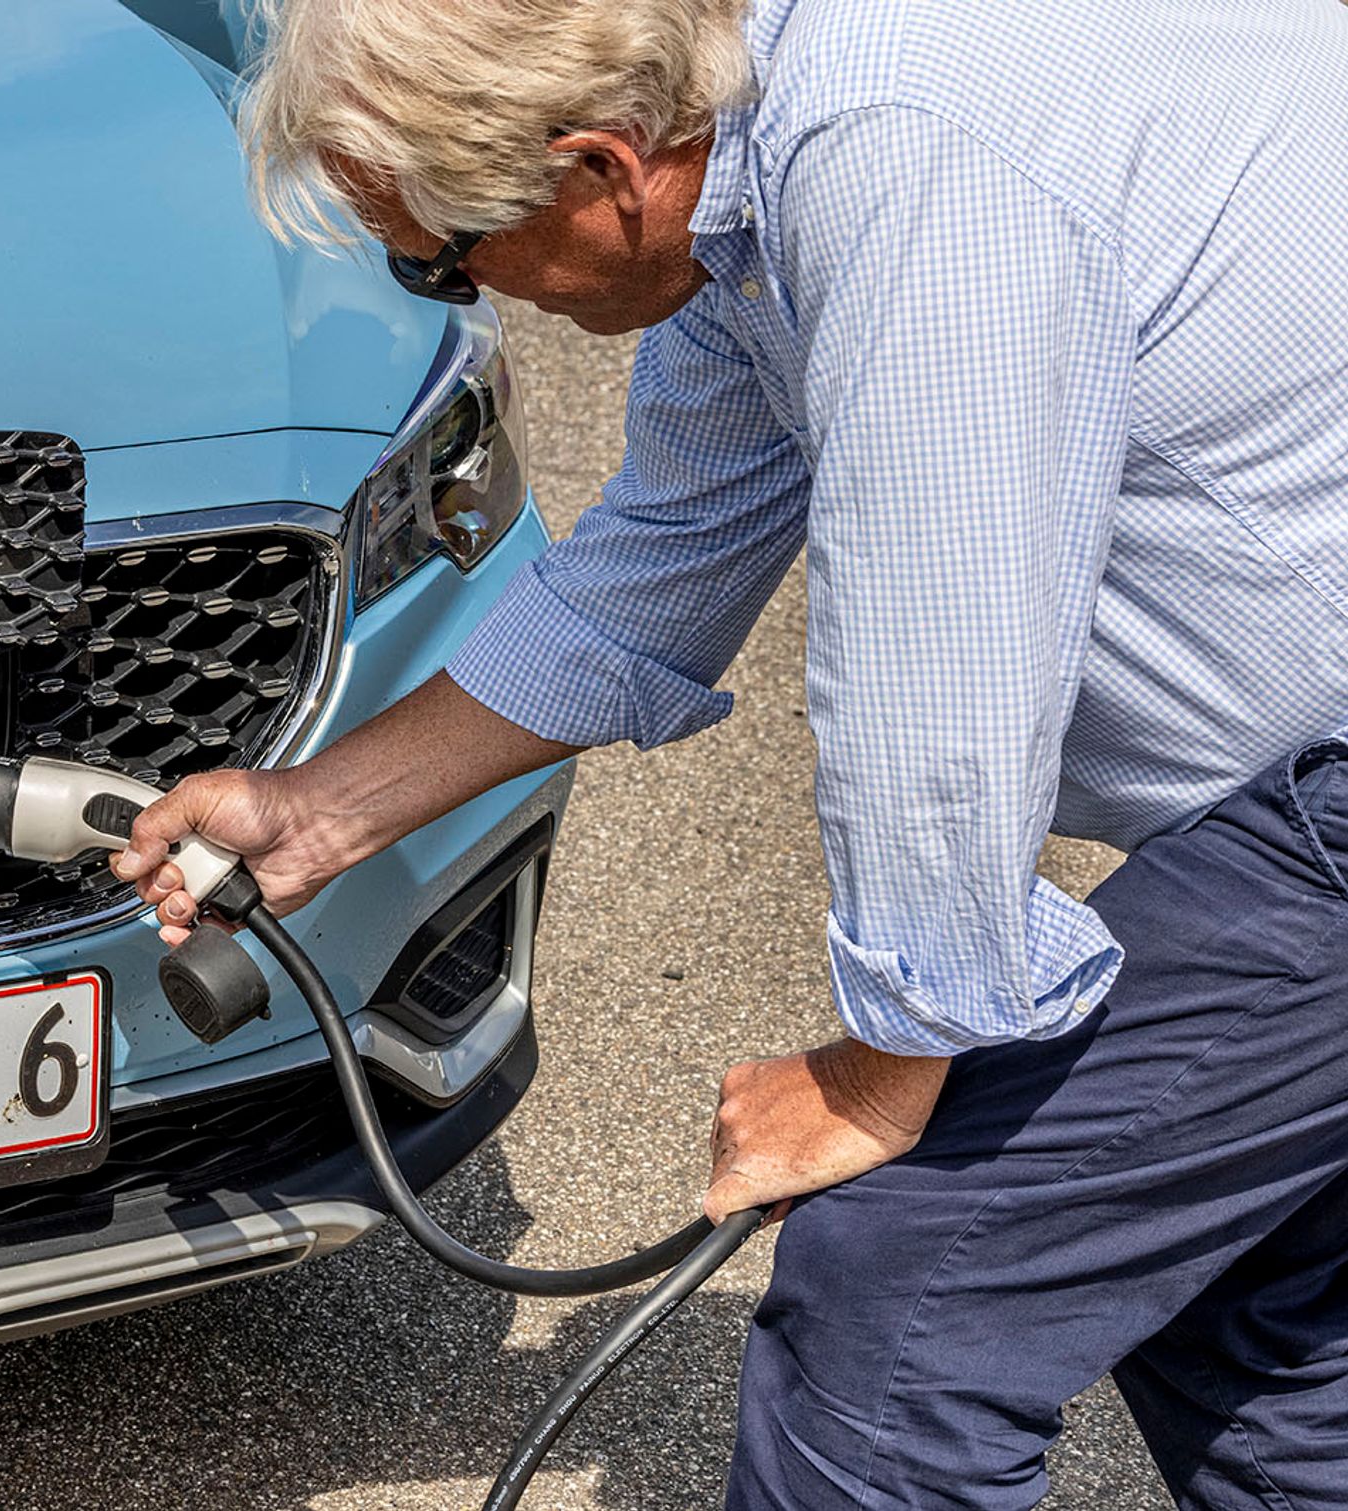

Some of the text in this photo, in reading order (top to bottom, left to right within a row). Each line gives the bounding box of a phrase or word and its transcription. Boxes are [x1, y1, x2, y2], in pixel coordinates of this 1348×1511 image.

[534, 1418, 557, 1445] CHANG
[558, 1394, 578, 1416] ZHOU
[607, 1328, 645, 1363] ELECTRON
